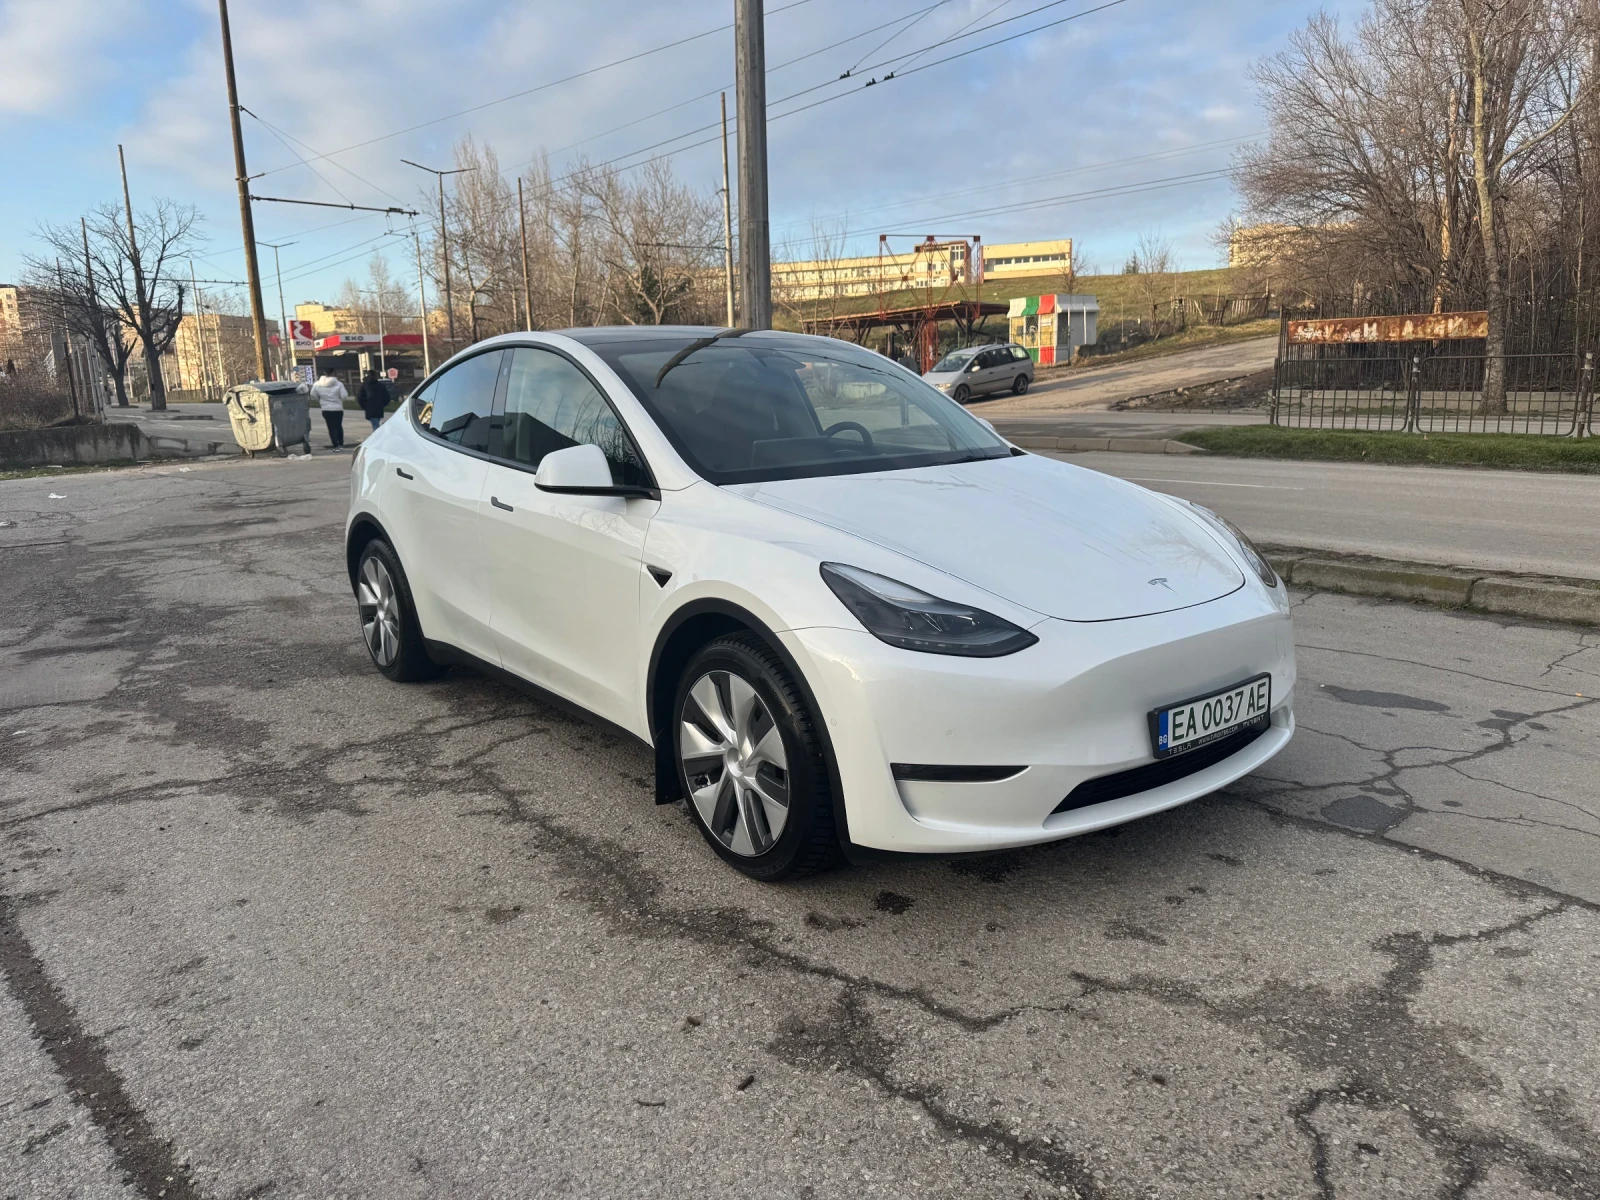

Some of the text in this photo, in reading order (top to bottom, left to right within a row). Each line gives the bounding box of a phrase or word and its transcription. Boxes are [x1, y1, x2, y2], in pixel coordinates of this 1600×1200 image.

[1172, 682, 1266, 742] EA 0037 AE
[1159, 734, 1168, 745] BG
[1168, 743, 1192, 755] TESLA
